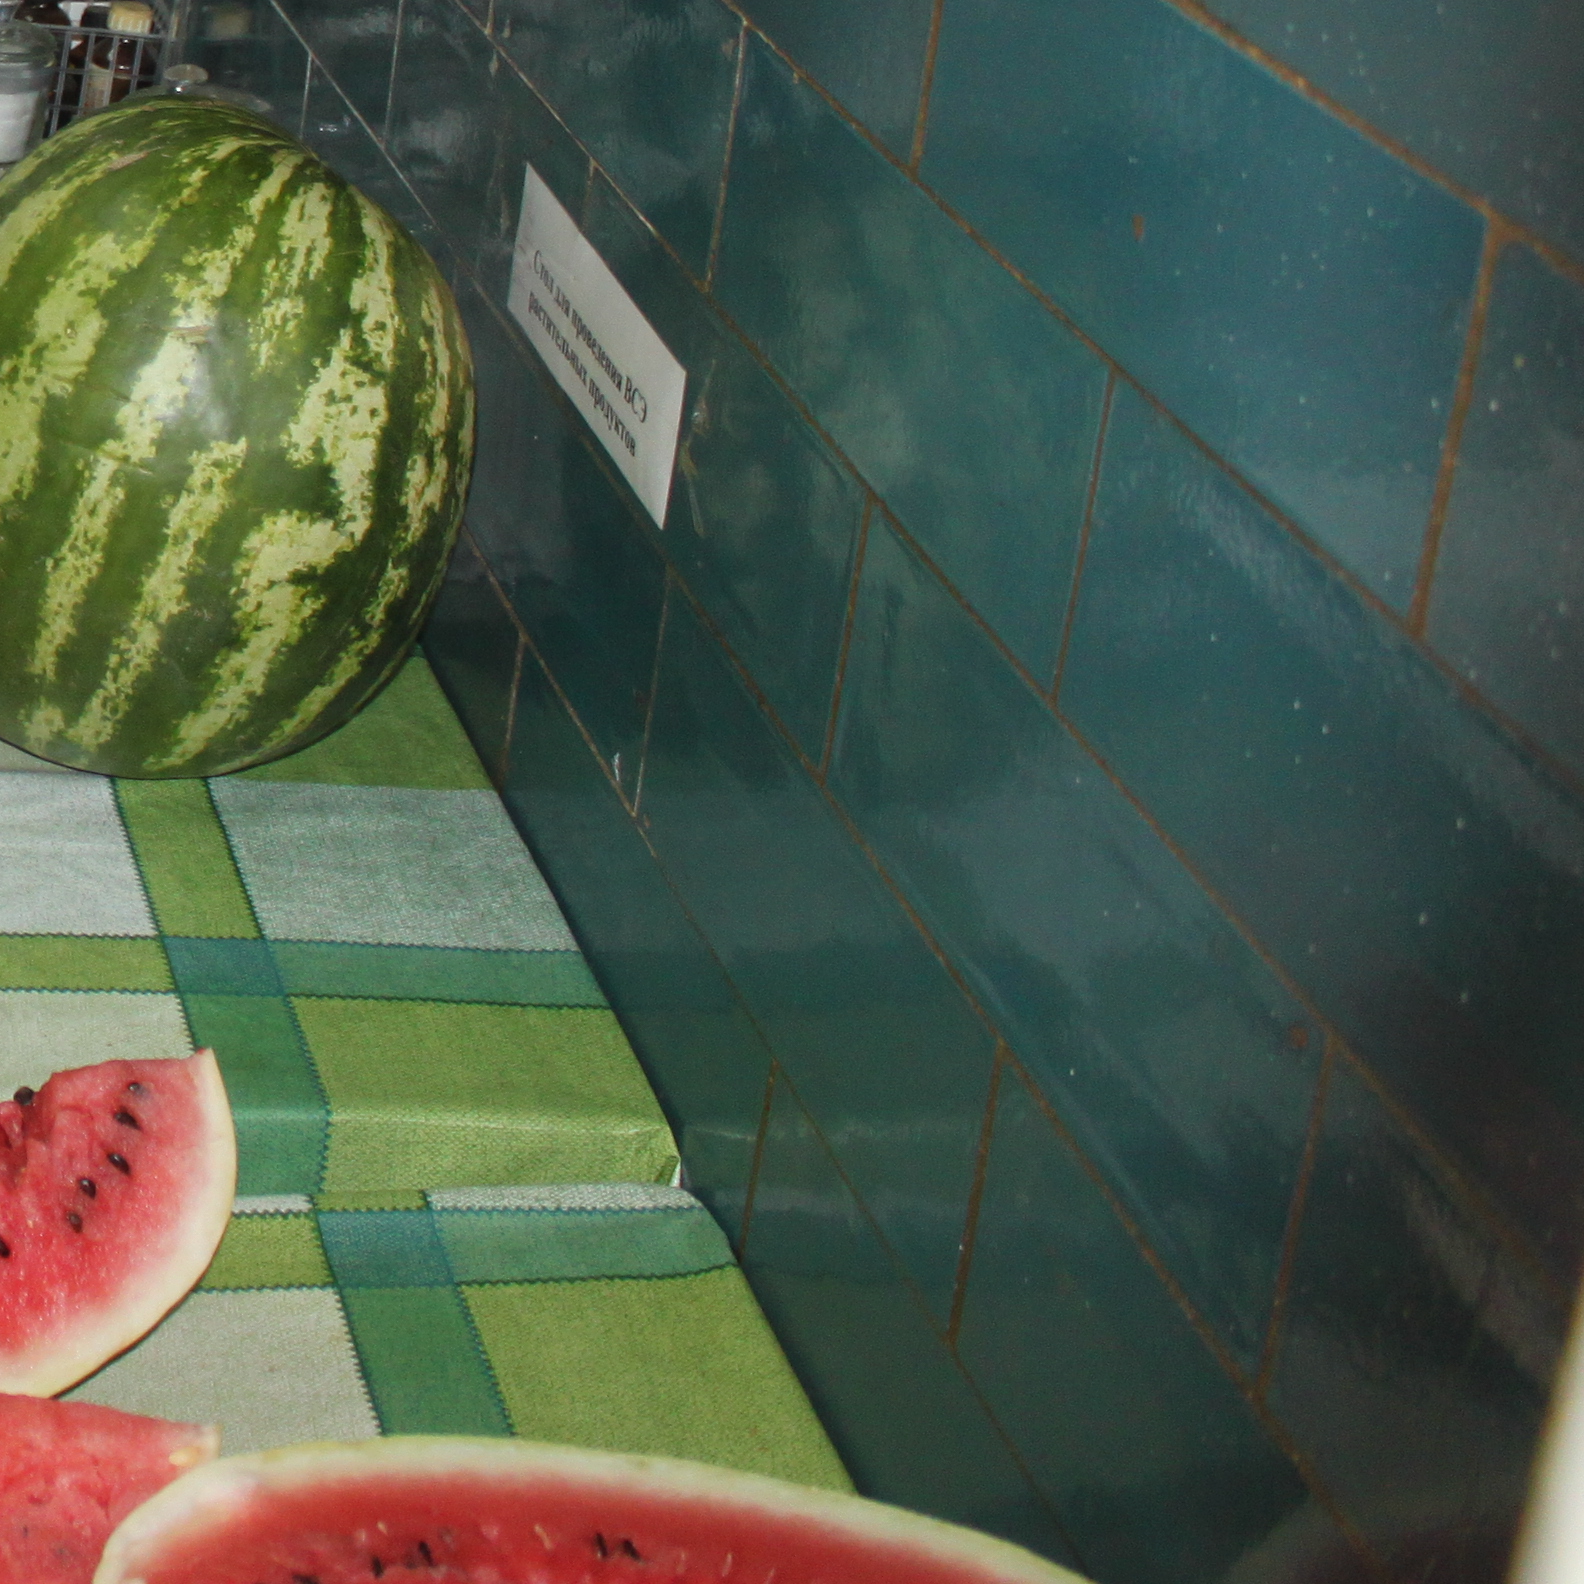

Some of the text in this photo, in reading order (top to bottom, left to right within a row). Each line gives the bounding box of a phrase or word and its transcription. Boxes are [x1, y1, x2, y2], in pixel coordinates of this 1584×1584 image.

[528, 290, 636, 457] растительных продуктов
[533, 249, 647, 423] Стол для проведения ВСЭ
